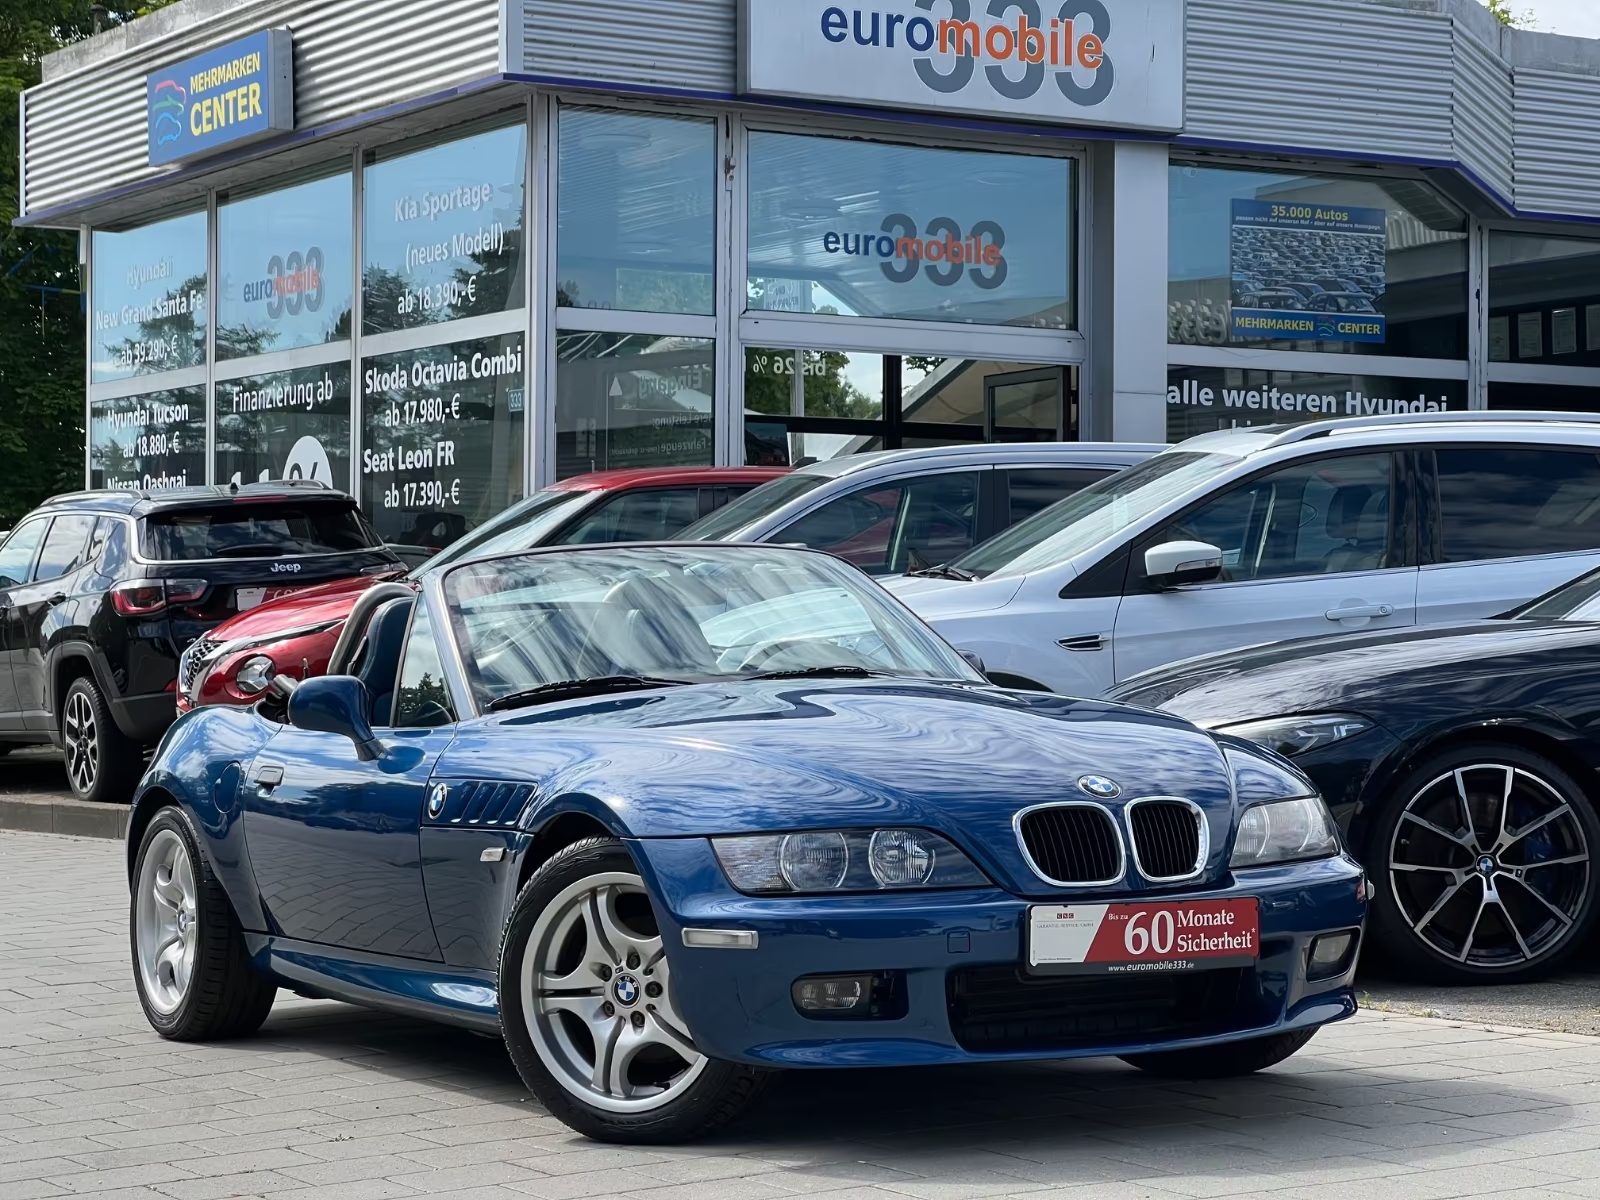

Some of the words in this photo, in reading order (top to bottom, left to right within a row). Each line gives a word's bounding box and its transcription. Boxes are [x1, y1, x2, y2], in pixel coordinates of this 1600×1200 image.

[821, 5, 1103, 69] euromobile
[190, 51, 260, 95] MEHRMARKEN
[190, 82, 262, 136] CENTER
[394, 196, 418, 222] Kia
[422, 182, 492, 221] Sportage
[1271, 205, 1312, 219] 35.000
[1315, 208, 1349, 221] Autos
[406, 242, 448, 274] (neues
[452, 222, 504, 258] Modell)
[823, 231, 1001, 266] euromobile
[96, 310, 119, 331] New
[121, 300, 153, 324] Grand
[156, 294, 187, 318] Santa
[189, 289, 203, 311] Fe
[397, 289, 413, 314] ab
[1235, 317, 1314, 332] MEHRMARKEN
[1337, 322, 1381, 335] CENTER
[121, 344, 133, 365] ab
[365, 364, 408, 394] Skoda
[412, 355, 467, 387] Octavia
[471, 345, 522, 379] Combi
[232, 380, 313, 413] Finanzierung
[317, 374, 333, 401] ab
[1166, 379, 1214, 406] alle
[1221, 385, 1337, 414] weiteren
[1345, 390, 1447, 416] Hyundai
[107, 407, 150, 434] Hyundai
[153, 402, 189, 423] Tucson
[384, 402, 399, 427] ab
[123, 443, 135, 458] ab
[363, 447, 394, 473] Seat
[398, 445, 433, 470] Leon
[436, 440, 455, 467] FR
[107, 475, 141, 490] Nissan
[384, 483, 399, 508] ab
[271, 562, 302, 573] Jeep
[1124, 910, 1175, 955] 60
[1177, 909, 1235, 928] Monate
[1108, 960, 1195, 972] www.euromobile333.de
